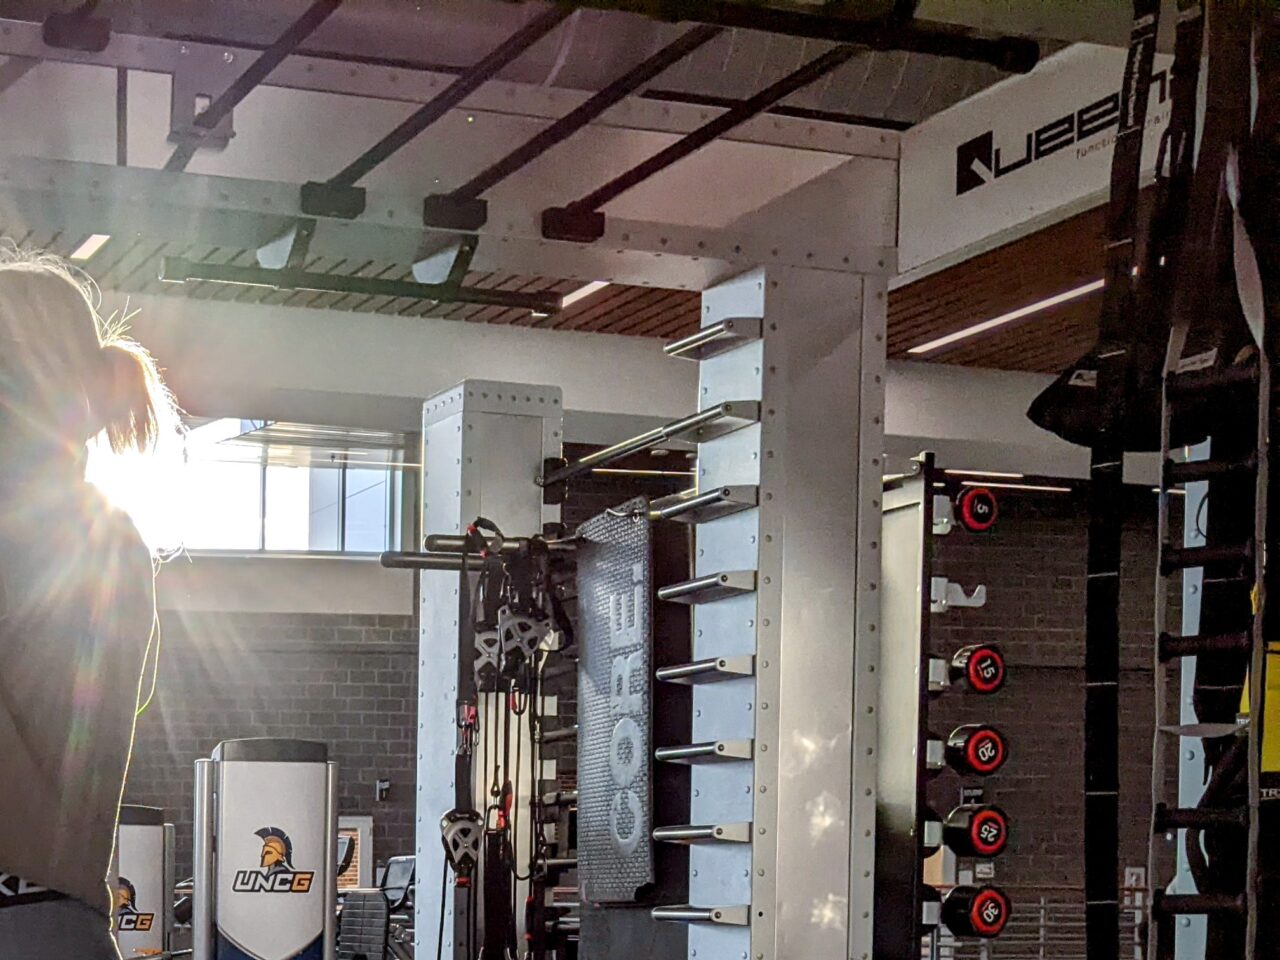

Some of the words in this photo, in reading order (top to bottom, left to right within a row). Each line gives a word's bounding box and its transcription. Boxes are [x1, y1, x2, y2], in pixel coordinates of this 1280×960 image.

[976, 503, 989, 514] 5
[981, 657, 995, 679] 15
[978, 740, 996, 762] 20
[1260, 788, 1280, 798] TR
[980, 824, 998, 842] 25
[232, 870, 314, 892] UNCG
[119, 913, 155, 931] CG
[983, 901, 999, 923] 30
